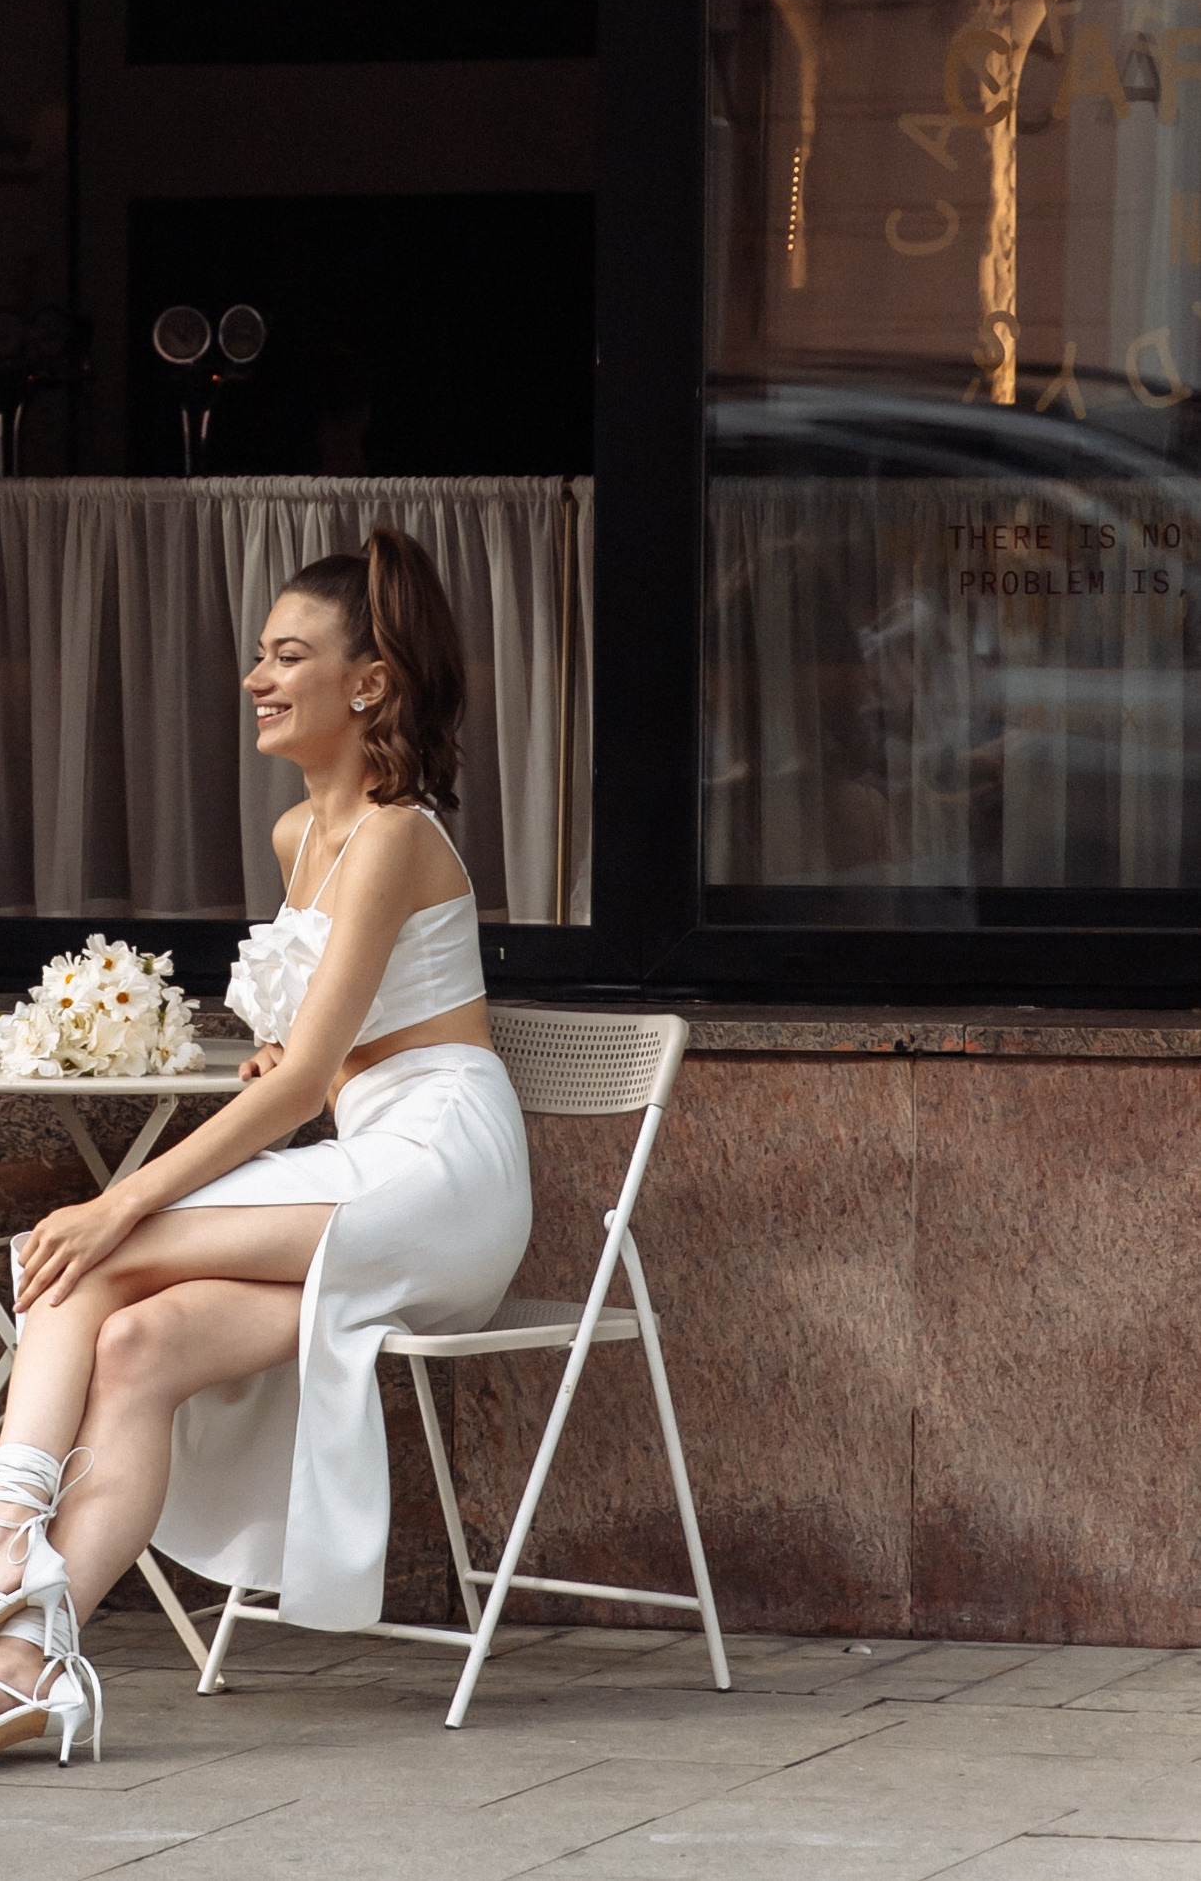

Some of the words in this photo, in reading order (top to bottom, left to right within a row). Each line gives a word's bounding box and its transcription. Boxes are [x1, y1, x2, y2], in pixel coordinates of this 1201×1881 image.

[948, 525, 1052, 550] THERE
[1079, 524, 1116, 550] IS
[1142, 523, 1182, 549] NO
[960, 570, 1105, 596] PROBLEM
[1132, 569, 1187, 598] IS,
